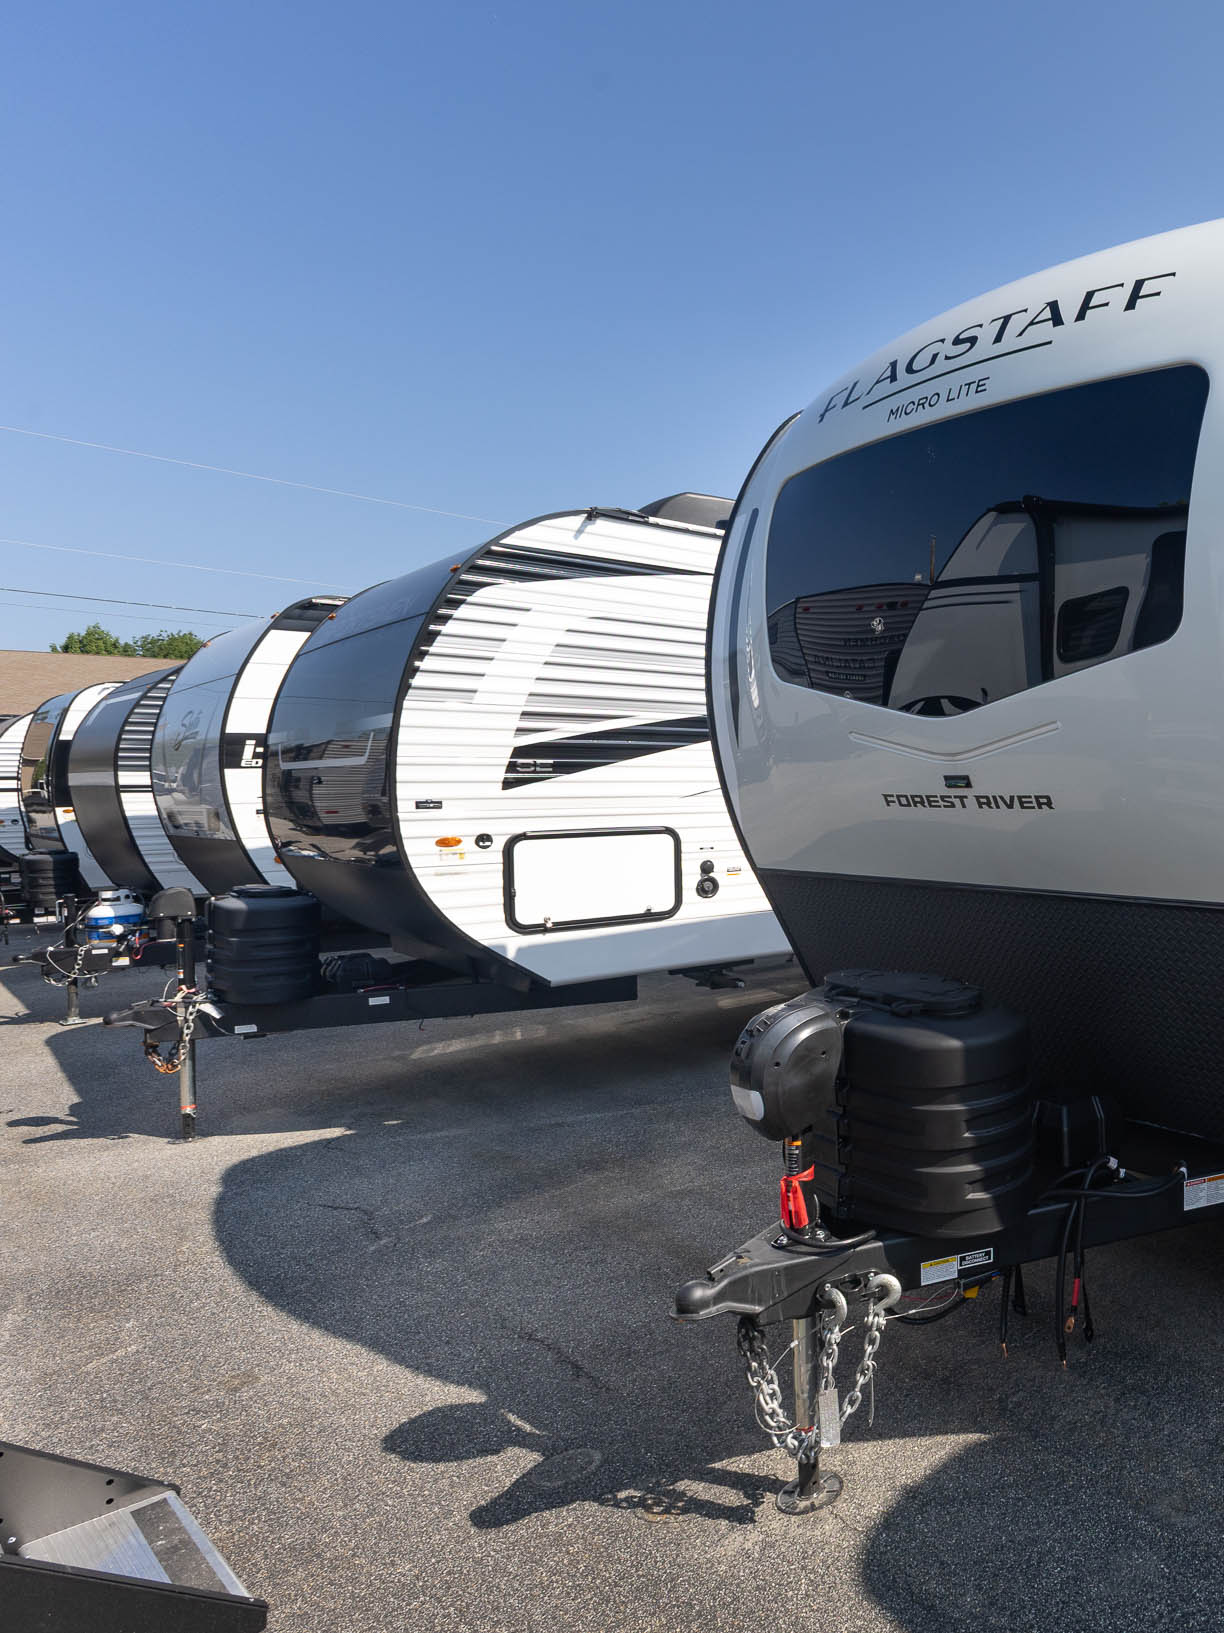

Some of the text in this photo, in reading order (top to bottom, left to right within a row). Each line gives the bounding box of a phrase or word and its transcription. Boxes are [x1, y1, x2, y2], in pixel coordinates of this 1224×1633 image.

[817, 271, 1177, 424] FLAGSTAFF
[887, 376, 991, 423] MICRO LITE
[881, 793, 1056, 810] FOREST RIVER
